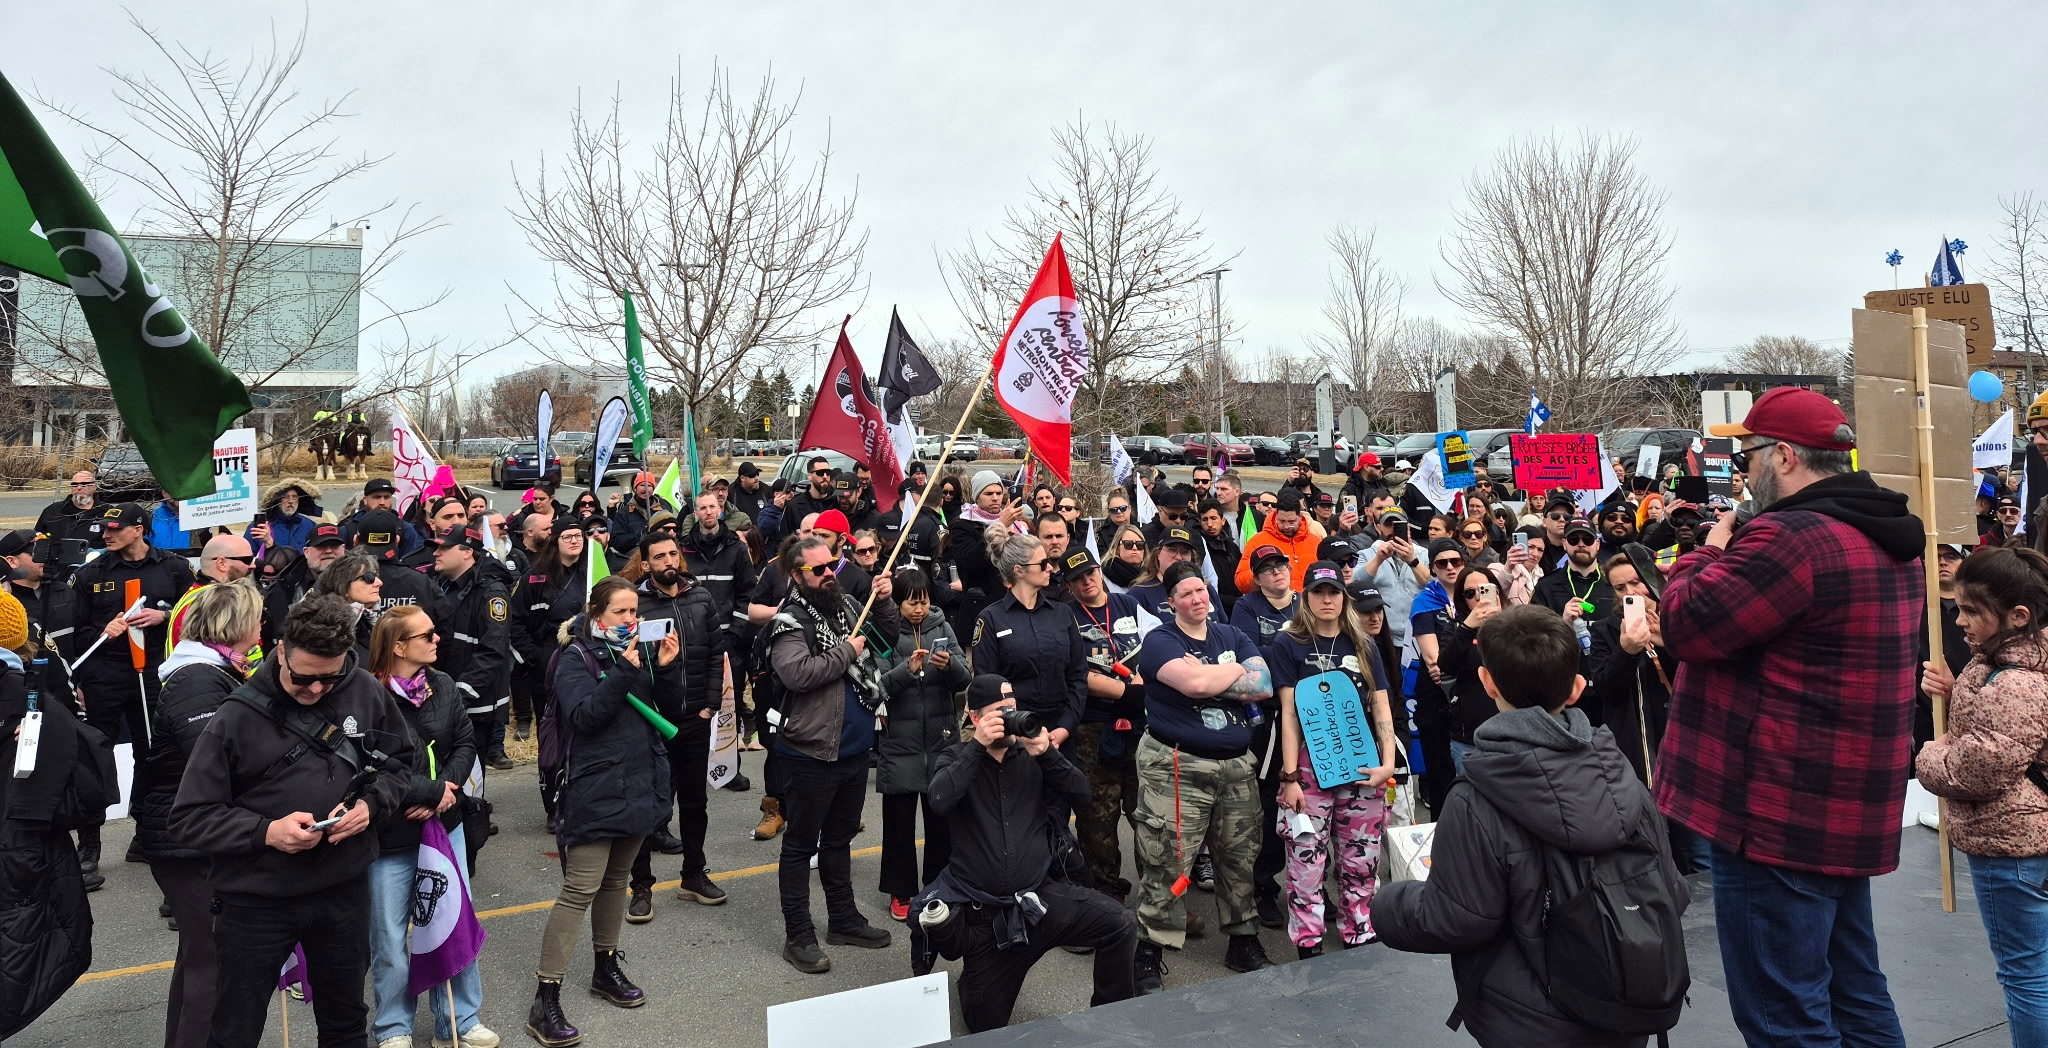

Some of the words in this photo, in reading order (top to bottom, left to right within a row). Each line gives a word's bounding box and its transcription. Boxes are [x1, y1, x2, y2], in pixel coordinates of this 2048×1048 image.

[1023, 330, 1035, 344] DU
[1034, 346, 1072, 399] MONTRÉAL
[1013, 380, 1025, 393] CSN
[214, 446, 248, 457] NAUTAIRE
[1523, 455, 1542, 464] DES
[1549, 455, 1589, 465] ACTES
[214, 455, 249, 476] UTTE
[380, 595, 417, 608] URITÉ
[1341, 700, 1367, 757] rabais
[1338, 757, 1351, 781] des
